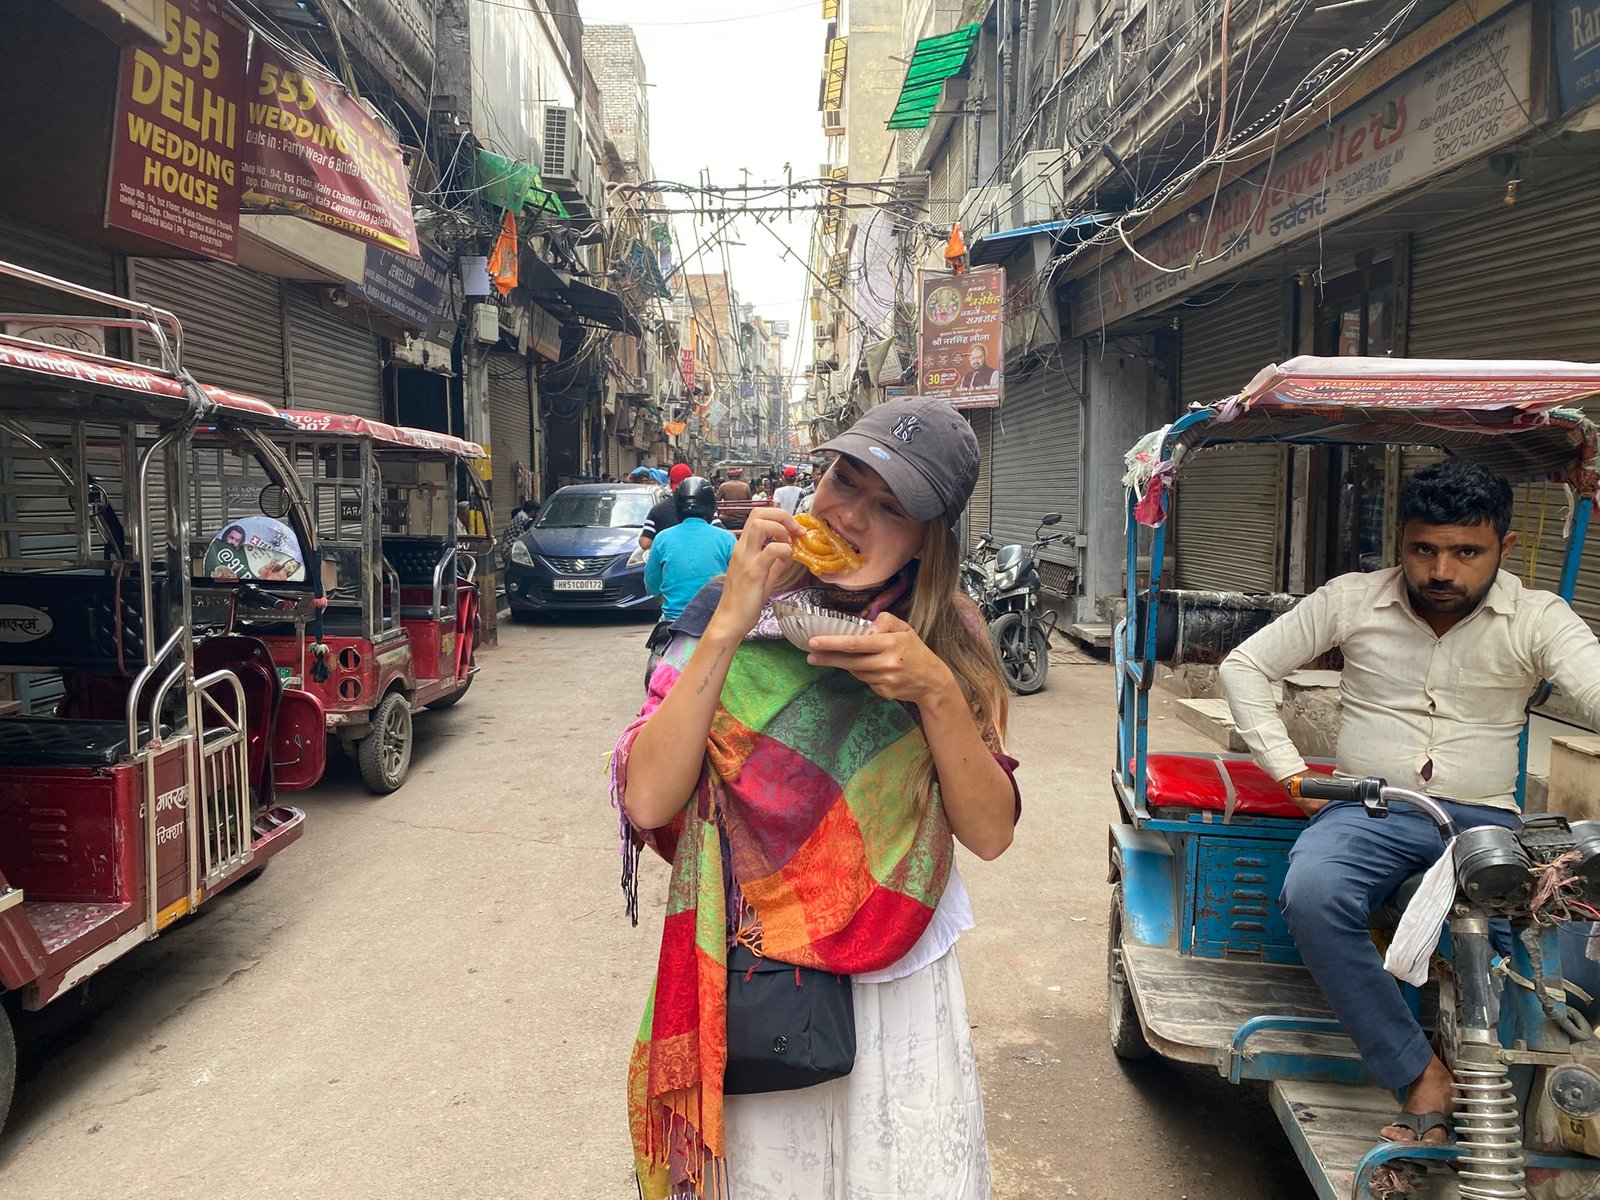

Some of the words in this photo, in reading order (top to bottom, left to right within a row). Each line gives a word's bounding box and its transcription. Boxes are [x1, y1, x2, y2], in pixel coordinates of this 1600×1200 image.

[163, 2, 220, 80] 555
[131, 48, 236, 150] DELHI
[259, 62, 317, 110] 555
[127, 112, 235, 186] WEDDING
[267, 133, 277, 149] in
[283, 139, 304, 160] Party
[305, 147, 327, 169] Wear
[328, 156, 335, 172] &
[336, 157, 360, 178] Bridal
[120, 183, 136, 196] Shop
[182, 206, 196, 218] Main
[196, 212, 216, 226] Chandni
[143, 156, 218, 211] HOUSE
[256, 165, 268, 176] No.
[270, 168, 282, 180] 94,
[284, 172, 295, 184] 1st
[314, 182, 331, 195] Main
[331, 189, 362, 207] Chandni
[362, 200, 388, 217] Chowk,
[260, 178, 287, 193] Church
[330, 202, 357, 217] Corner
[357, 210, 370, 222] Old
[163, 210, 182, 224] Church
[928, 374, 940, 384] 30
[157, 820, 184, 846] रिक्शा
